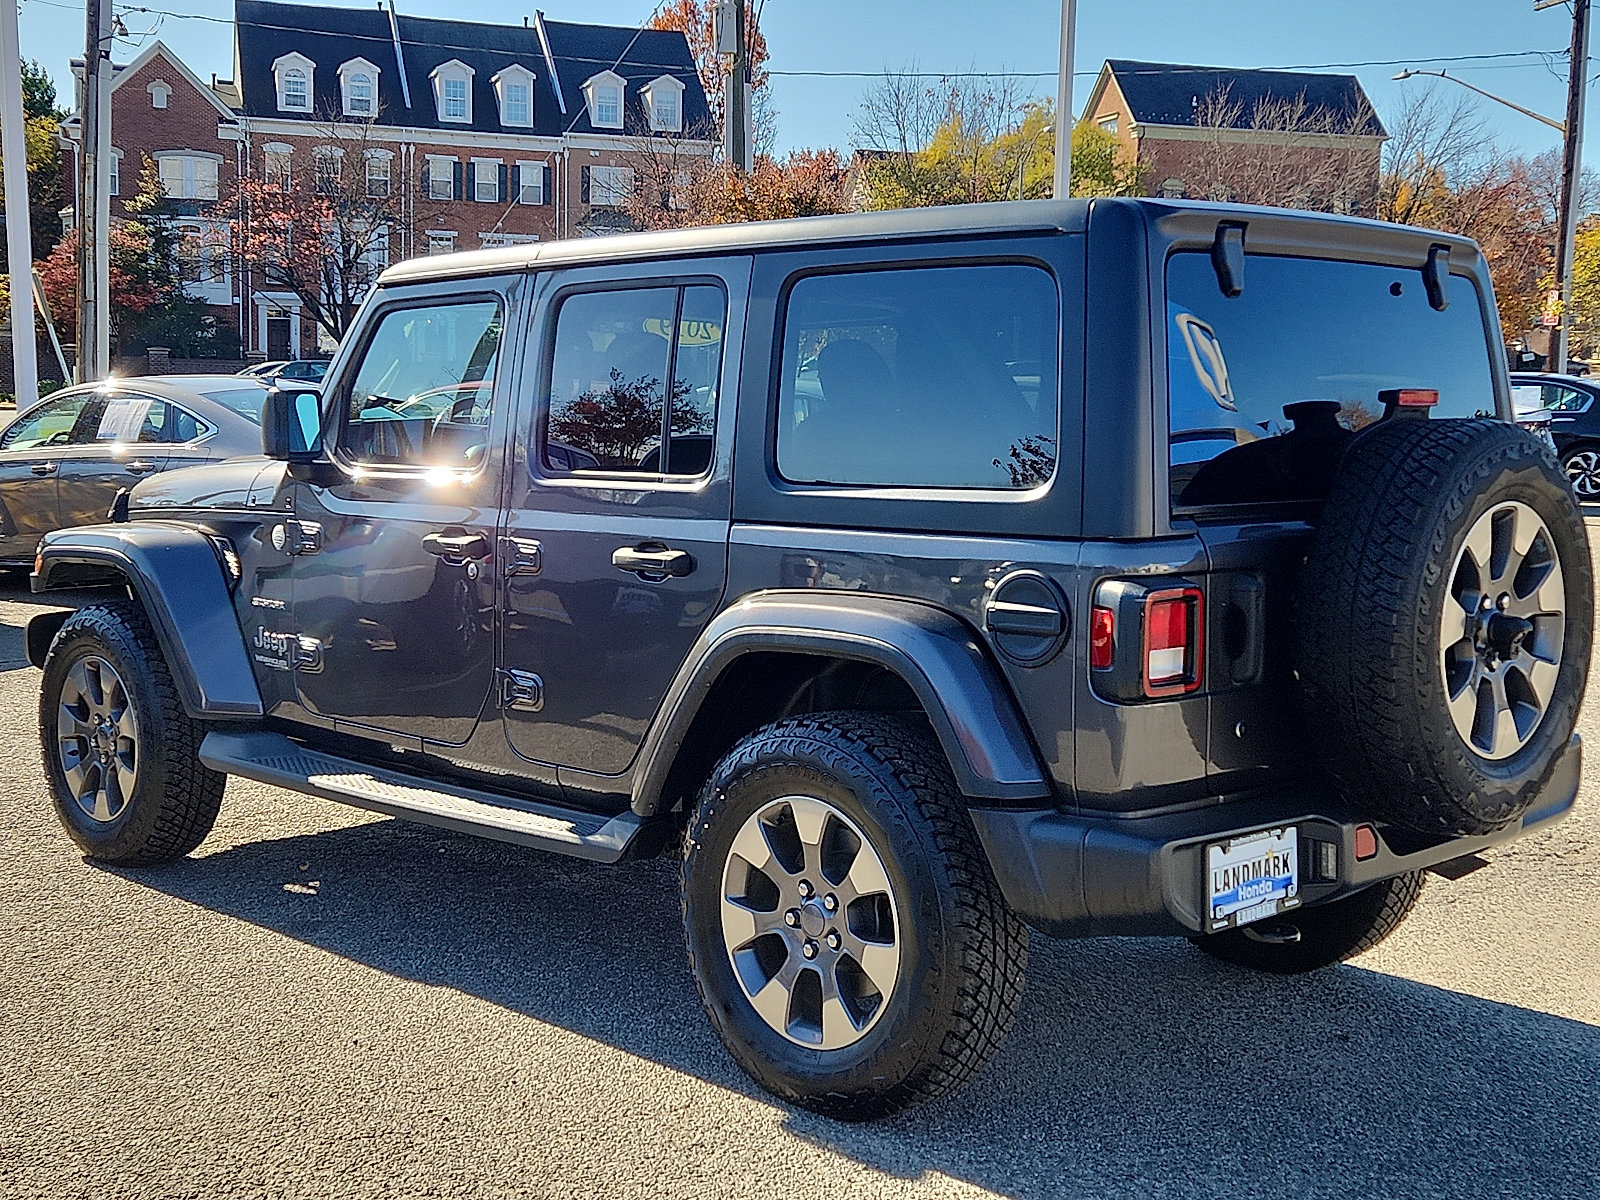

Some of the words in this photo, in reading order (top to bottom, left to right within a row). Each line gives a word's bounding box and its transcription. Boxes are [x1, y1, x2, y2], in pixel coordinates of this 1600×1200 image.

[253, 625, 288, 657] Jeep
[1213, 852, 1290, 894] LANDMARK
[1237, 880, 1273, 901] Honda
